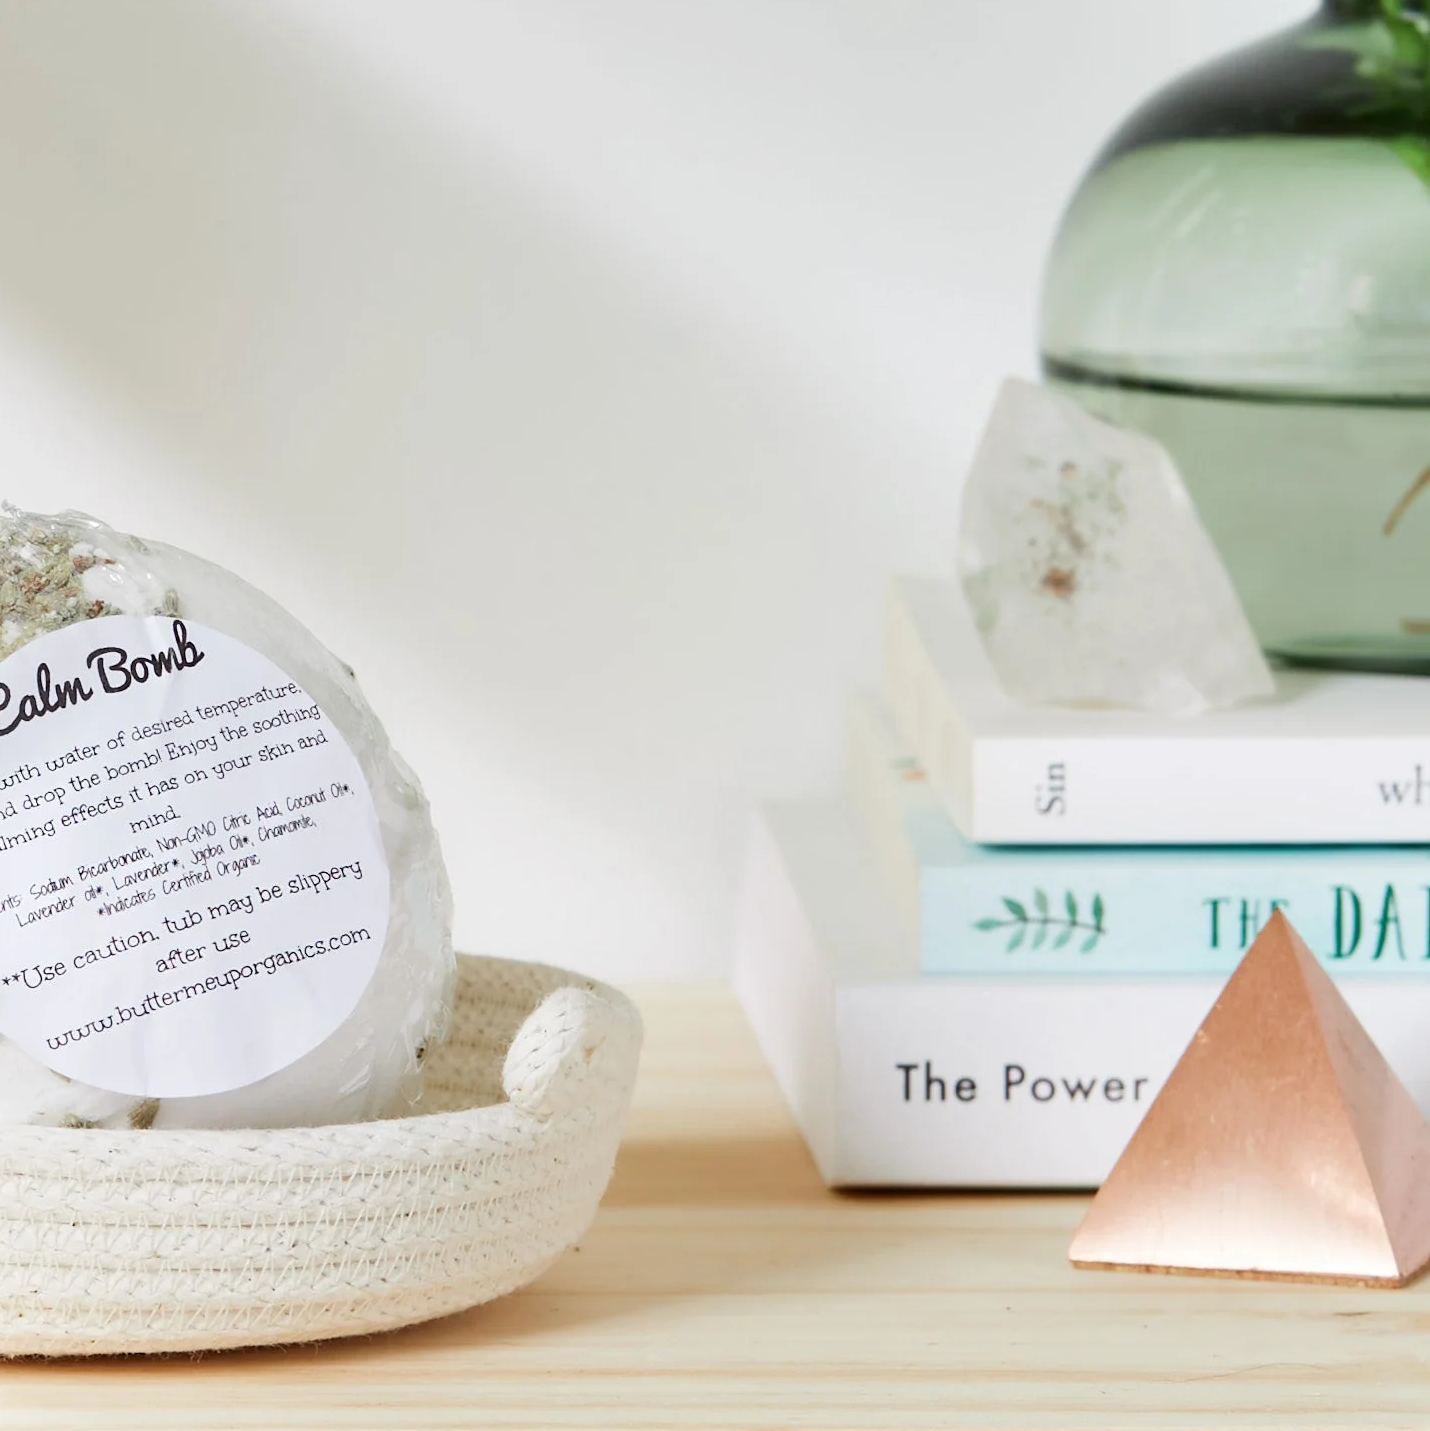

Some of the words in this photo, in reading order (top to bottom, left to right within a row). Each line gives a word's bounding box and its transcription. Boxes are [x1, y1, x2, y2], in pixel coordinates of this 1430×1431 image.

[86, 619, 204, 694] Bomb
[23, 786, 66, 810] drop
[69, 772, 101, 793] the
[104, 749, 162, 780] bomb!
[165, 736, 218, 761] Enjoy
[220, 725, 248, 743] the
[254, 704, 321, 734] soothing
[46, 745, 100, 772] water
[107, 731, 125, 750] of
[132, 711, 194, 742] desired
[61, 795, 124, 827] effects
[129, 786, 143, 803] it
[146, 777, 179, 797] has
[184, 769, 208, 784] on
[212, 755, 253, 780] your
[259, 743, 295, 762] skin
[298, 730, 328, 748] and
[29, 876, 74, 900] Sodium
[77, 846, 154, 881] Bicarbonate,
[156, 822, 216, 852] Non-GMO
[222, 815, 251, 832] Citric
[286, 788, 326, 812] Coconut
[162, 864, 212, 895] Certified
[217, 854, 260, 877] Organic
[15, 895, 76, 928] Lavender
[191, 844, 225, 865] Jojoba
[162, 910, 202, 934] tub
[208, 896, 253, 919] may
[256, 885, 283, 904] be
[288, 861, 363, 894] slippery
[1203, 897, 1289, 949] TH
[155, 946, 207, 972] after
[213, 930, 251, 952] use
[46, 927, 371, 1051] www.buttermeuporganics.com
[896, 1060, 977, 1102] The
[1004, 1064, 1148, 1102] Power
